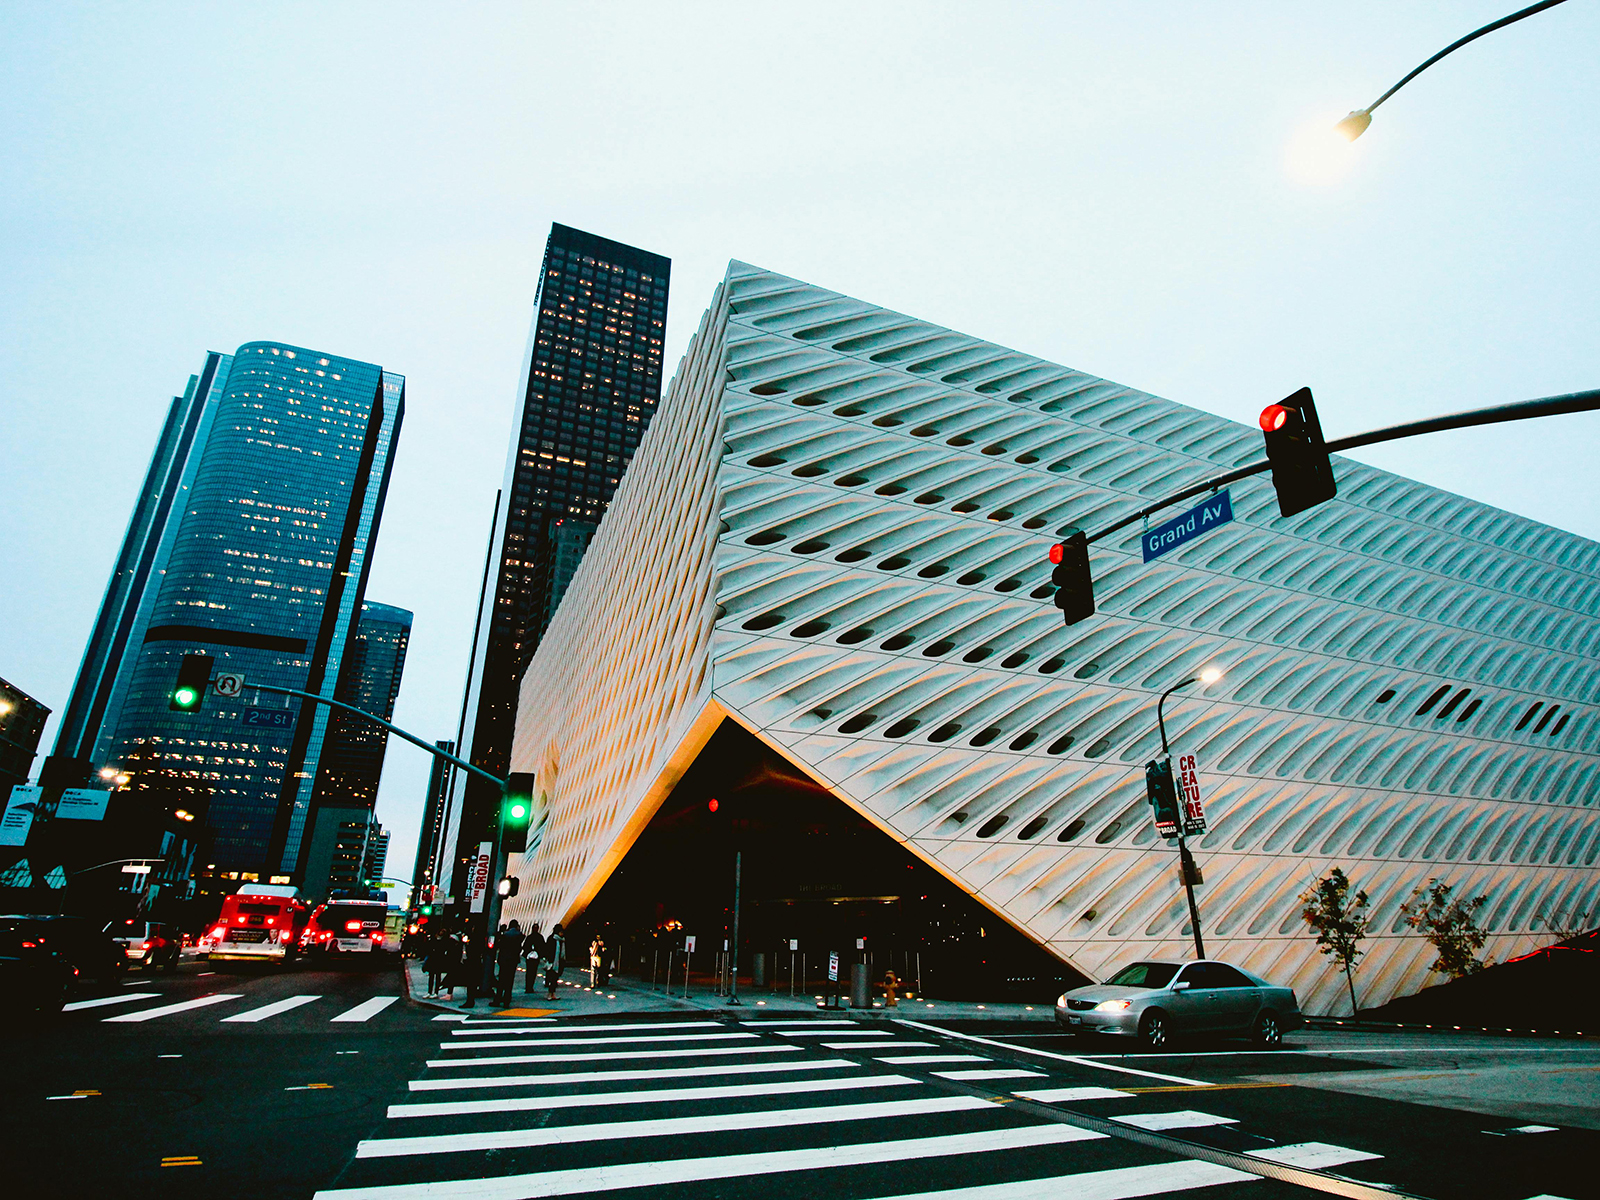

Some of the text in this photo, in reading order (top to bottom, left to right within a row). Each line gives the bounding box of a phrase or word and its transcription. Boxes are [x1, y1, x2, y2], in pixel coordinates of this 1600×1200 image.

[1149, 503, 1222, 552] Grand Av
[248, 711, 287, 725] 2nd St
[1179, 755, 1196, 772] CR
[1181, 770, 1198, 787] EA
[1183, 785, 1200, 803] TU
[1186, 801, 1204, 819] RE
[475, 854, 490, 889] BROAD
[814, 883, 843, 891] BROAD
